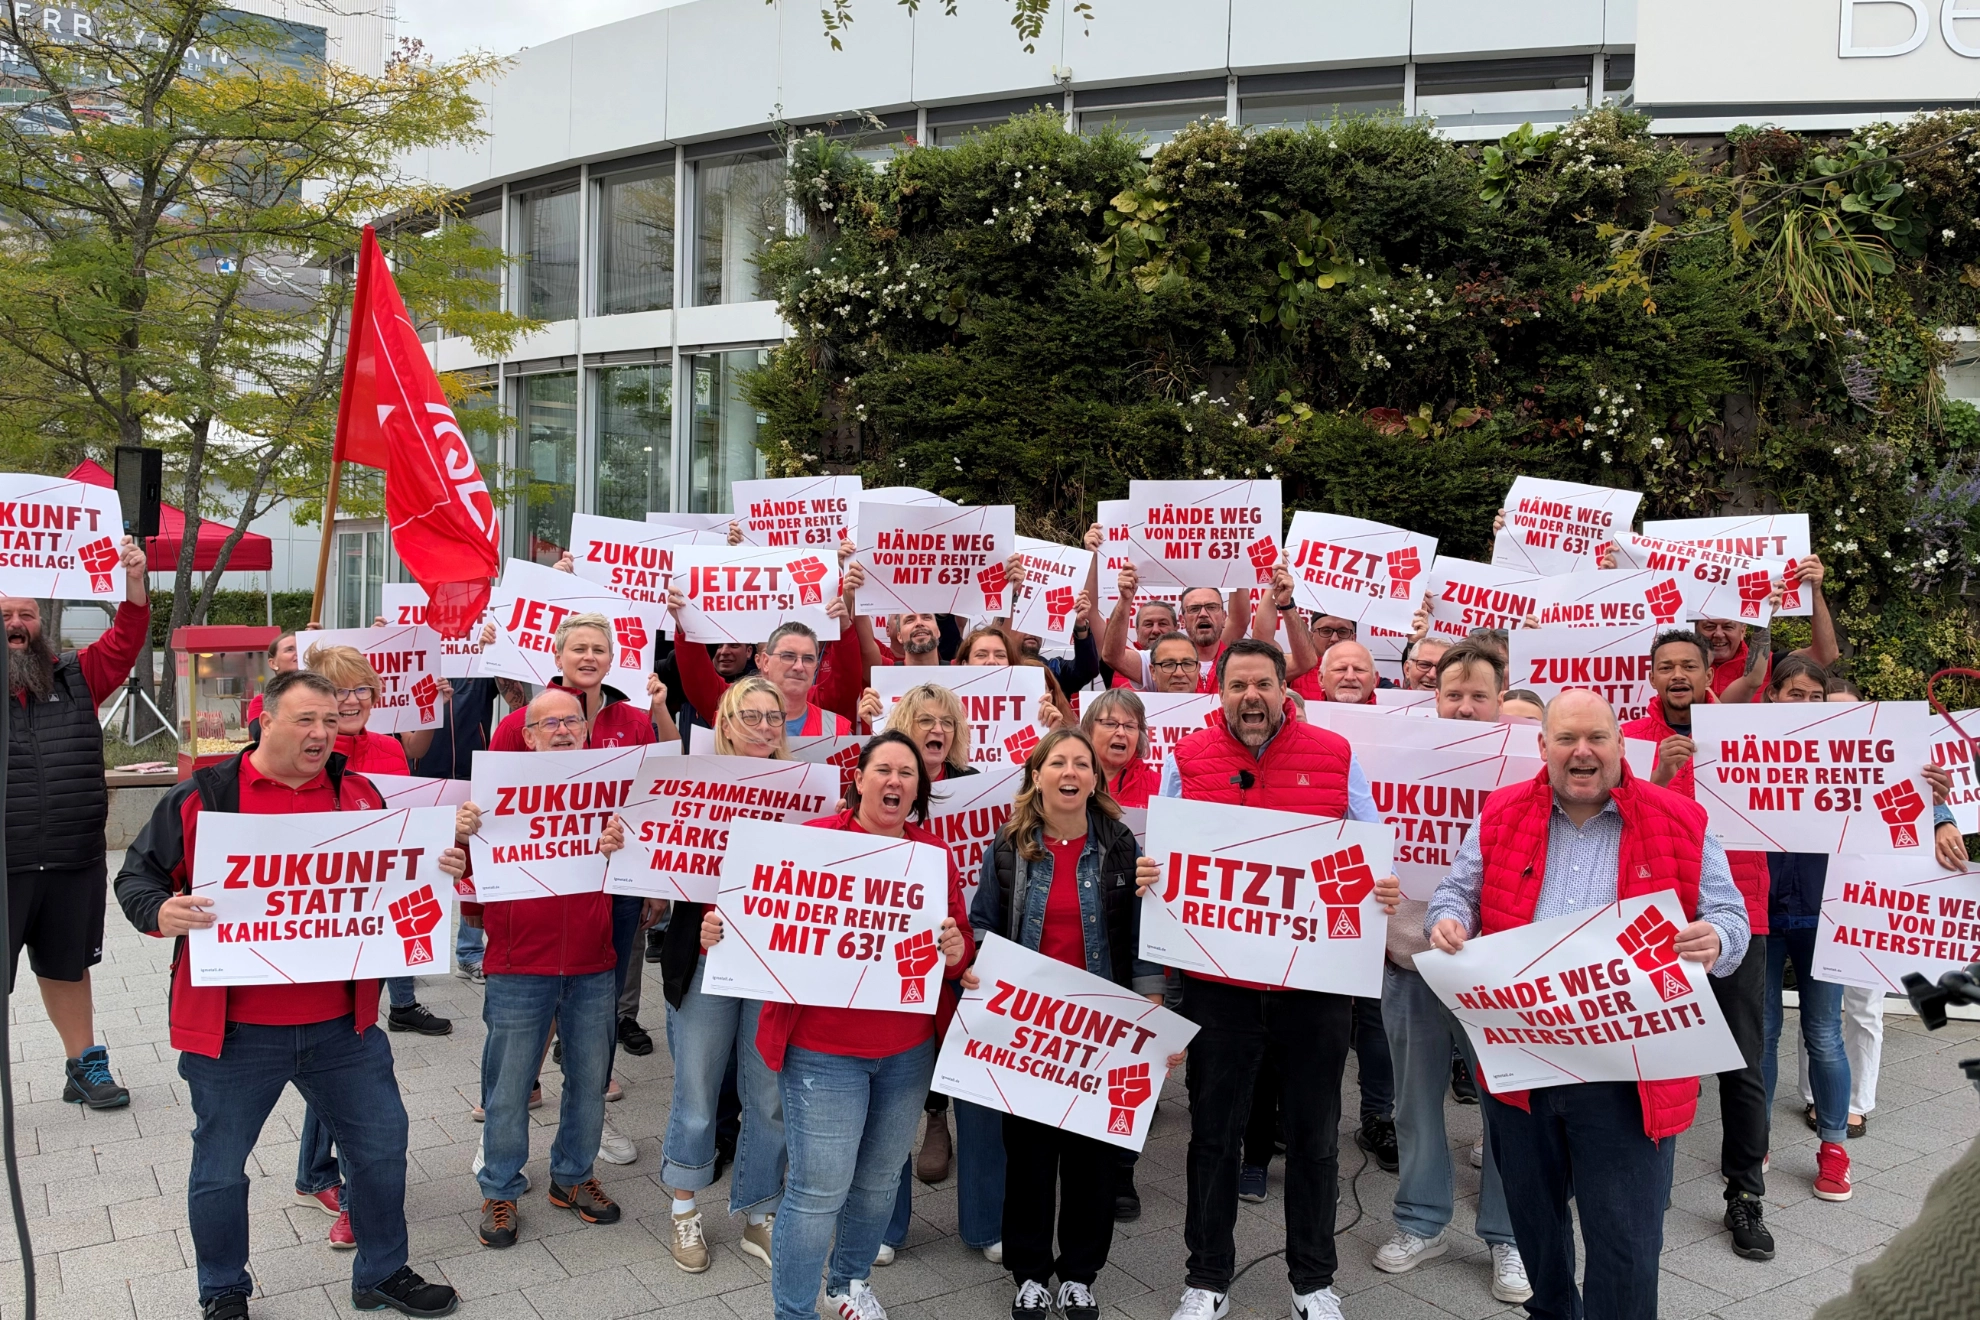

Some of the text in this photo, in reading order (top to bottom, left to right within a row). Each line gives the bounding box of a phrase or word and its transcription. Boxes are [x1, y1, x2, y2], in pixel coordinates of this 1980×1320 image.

[0, 502, 101, 532] KUNFT
[750, 498, 847, 518] HÄNDE WEG
[1148, 504, 1261, 524] HÄNDE WEG
[1519, 497, 1612, 526] HÄNDE WEG
[748, 515, 842, 530] VON DER RENTE
[1144, 528, 1175, 540] VON
[1178, 528, 1206, 540] DER
[1210, 528, 1254, 539] RENTE
[1514, 515, 1603, 540] VON DER RENTE
[0, 530, 62, 552] TATT
[768, 528, 832, 546] MIT 63!
[878, 529, 994, 551] HÄNDE WEG
[1165, 542, 1240, 559] MIT 63!
[1525, 530, 1589, 555] MIT 63!
[0, 554, 75, 569] SCHLAG!
[587, 541, 673, 571] ZUKUN
[873, 553, 986, 566] VON DER RENTE
[1024, 553, 1076, 578] ENHALT
[1294, 540, 1383, 579] JETZT
[1632, 536, 1662, 550] VON
[1666, 543, 1697, 558] DER
[1700, 550, 1751, 570] RENTE
[611, 568, 673, 590] STATT
[893, 568, 969, 584] MIT 63!
[1646, 551, 1731, 585] MIT 63!
[688, 567, 782, 600] JETZT
[1304, 568, 1386, 599] REICHT'S!
[703, 594, 794, 611] REICHT'S!
[1541, 603, 1644, 624] HÄNDE WEG
[1530, 656, 1652, 684] ZUKUNF
[1721, 735, 1895, 763] HÄNDE WEG
[1716, 767, 1885, 784] VON DER RENTE
[649, 779, 826, 813] ZUSAMMENHALT
[672, 801, 705, 819] IST
[1749, 788, 1862, 812] MIT 63!
[529, 812, 614, 839] STATT
[638, 820, 729, 851] STÄRKS
[224, 848, 424, 889] ZUKUNFT
[650, 849, 724, 876] MARK
[752, 860, 856, 902] HÄNDE
[864, 878, 924, 910] WEG
[1162, 852, 1305, 910] JETZT
[265, 887, 369, 916] STATT
[743, 895, 911, 933] VON DER RENTE
[1843, 881, 1980, 920] HÄNDE WE
[218, 916, 384, 943] KAHLSCHLAG!
[1182, 900, 1318, 942] REICHT'S!
[1888, 913, 1934, 936] VON
[768, 923, 886, 962] MIT 63!
[1833, 925, 1980, 963] ALTERSTEILZ
[1455, 958, 1632, 1010] HÄNDE WEG
[986, 979, 1157, 1055] ZUKUNFT
[1516, 990, 1638, 1028] VON DER
[1482, 1002, 1706, 1046] ALTERSTEILZEIT!
[1010, 1026, 1098, 1069] STATT
[964, 1038, 1102, 1095] KAHLSCHLAG!
